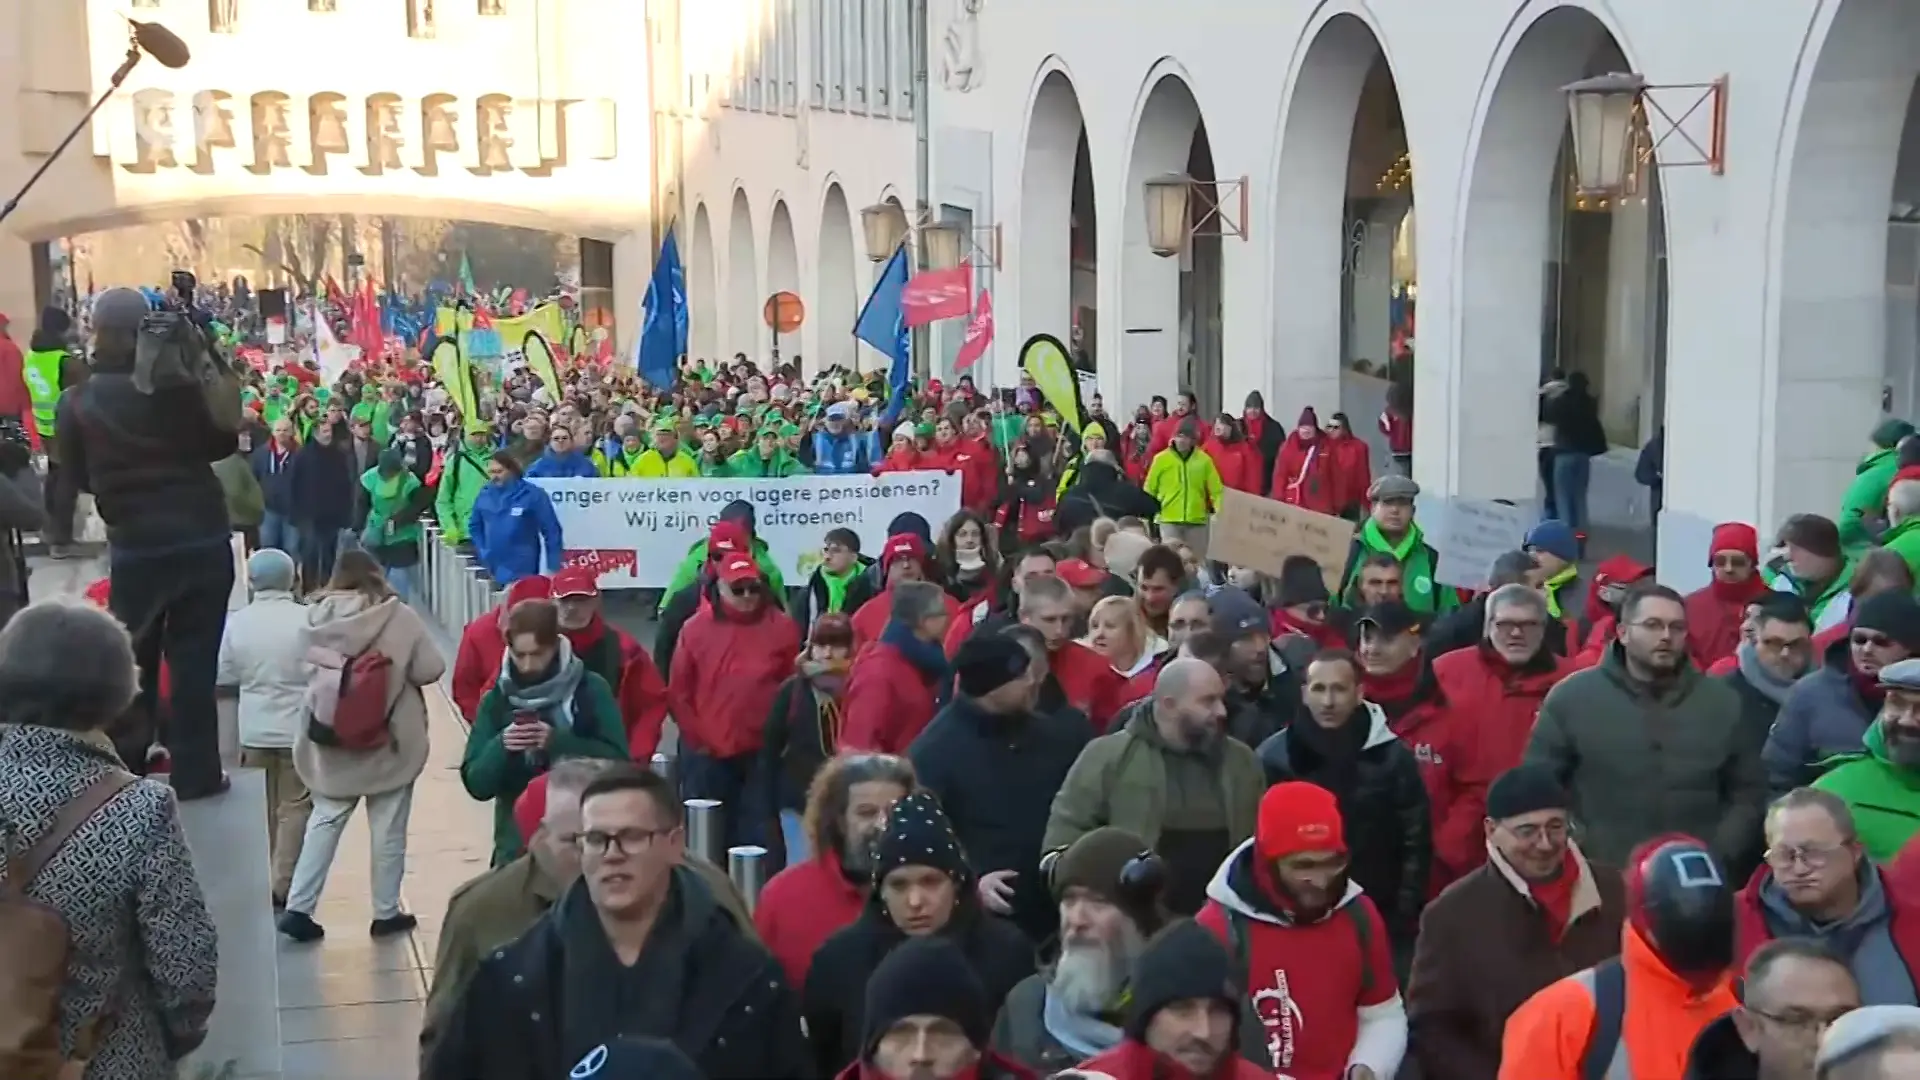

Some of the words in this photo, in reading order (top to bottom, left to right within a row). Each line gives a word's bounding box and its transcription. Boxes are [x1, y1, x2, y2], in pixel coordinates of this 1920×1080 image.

[550, 490, 612, 508] anger
[617, 487, 693, 504] werken
[698, 490, 743, 503] voor
[749, 486, 812, 506] lagere
[818, 478, 941, 505] pensioenen?
[624, 510, 658, 533] Wij
[663, 510, 700, 532] zijn
[763, 505, 864, 527] citroenen!
